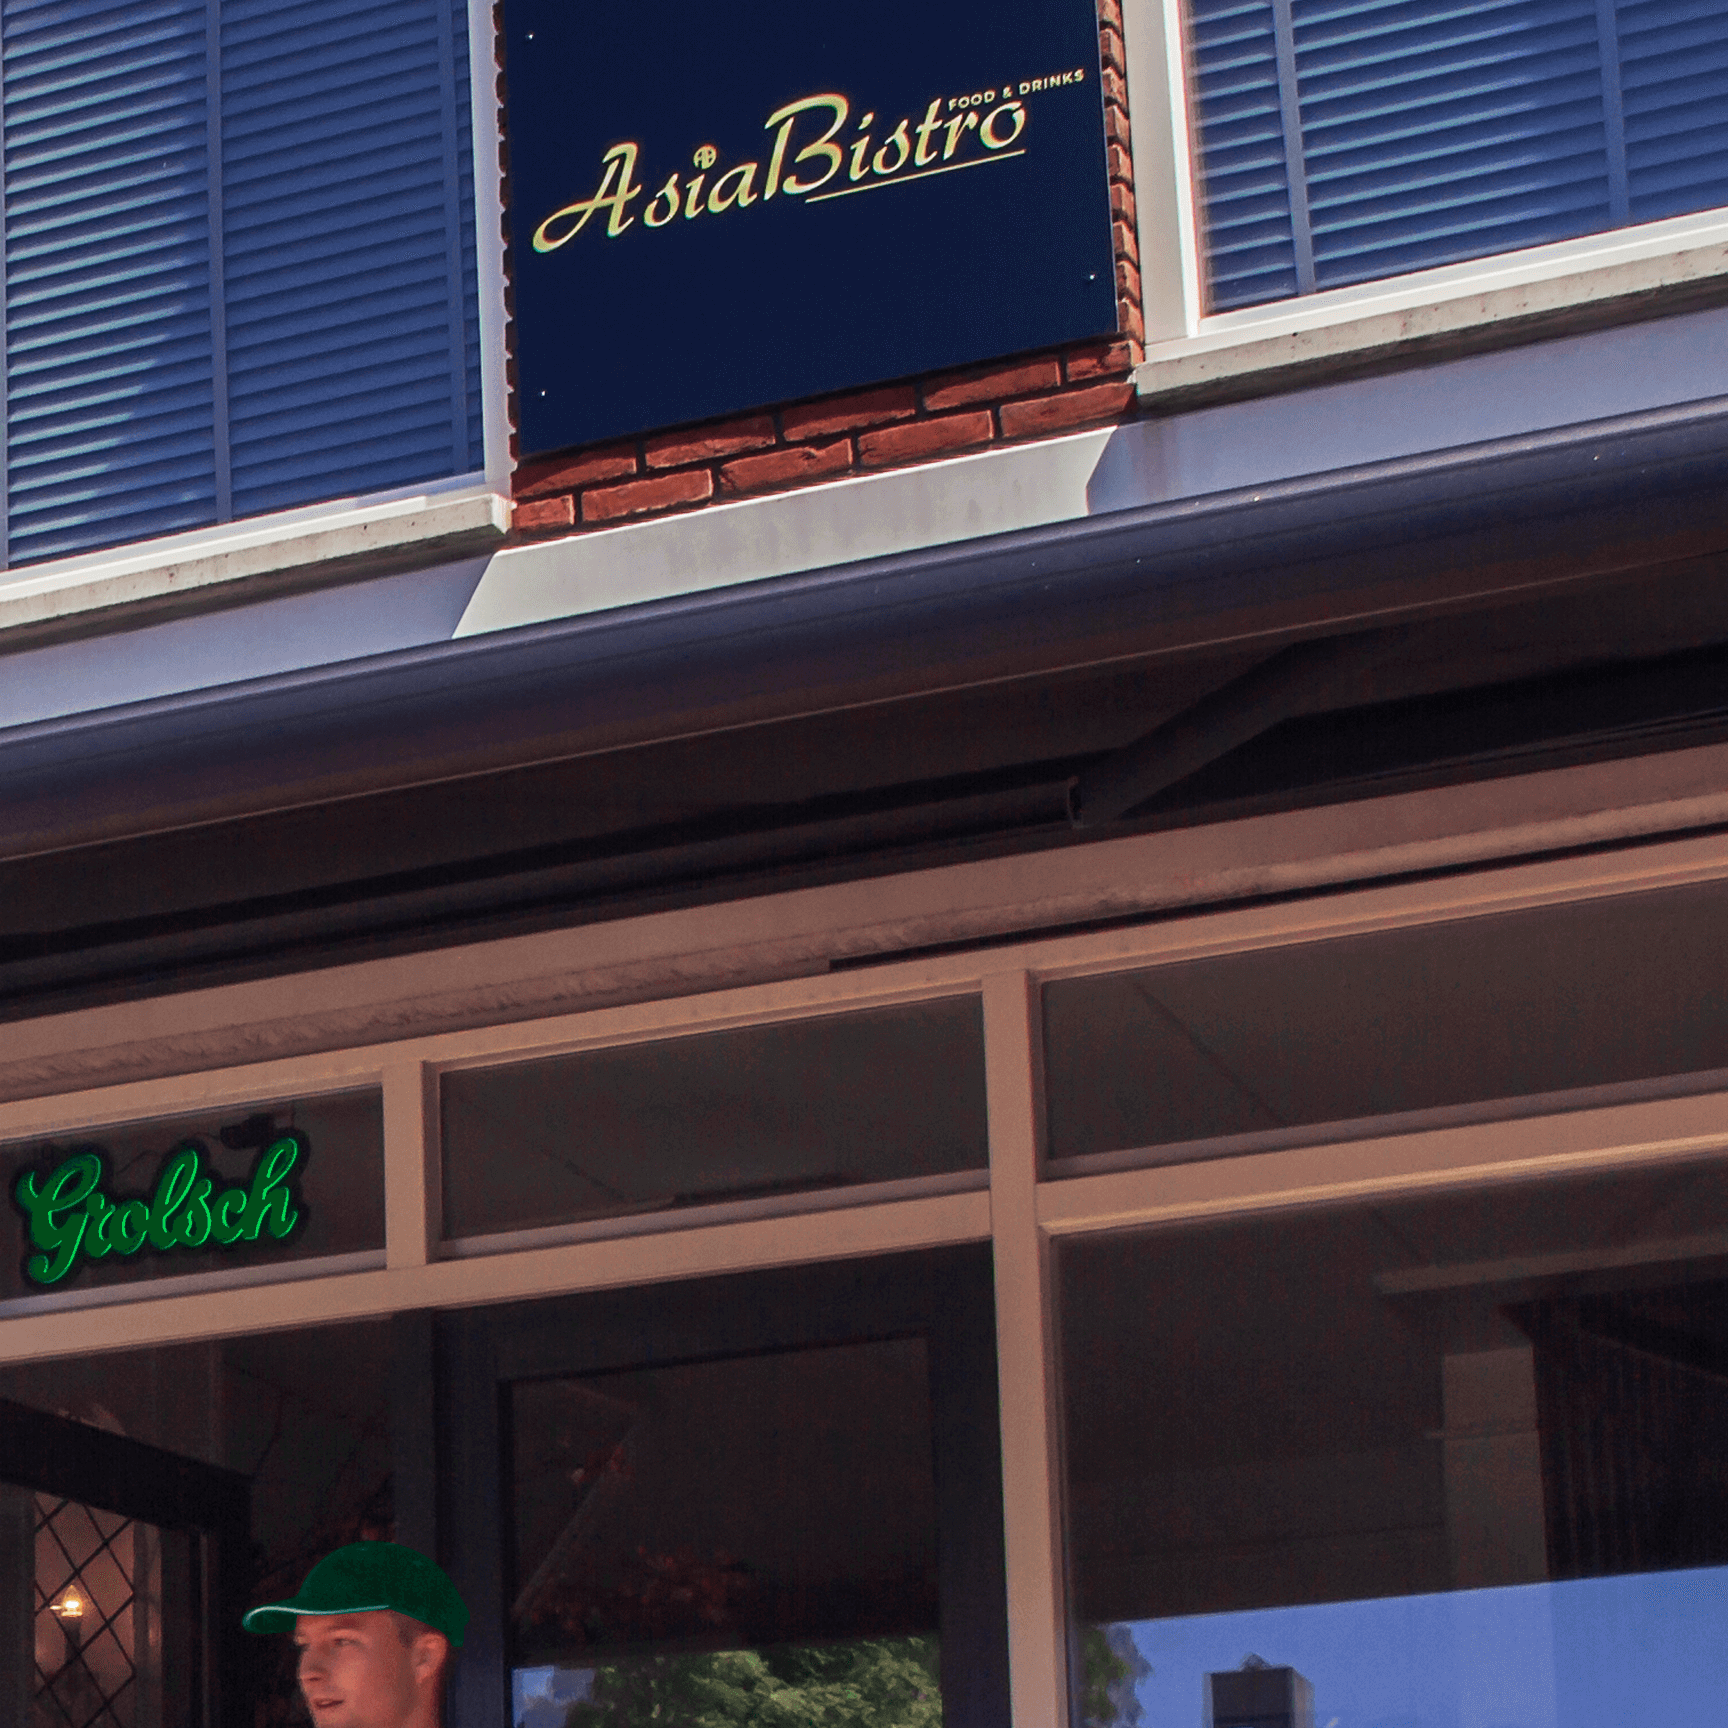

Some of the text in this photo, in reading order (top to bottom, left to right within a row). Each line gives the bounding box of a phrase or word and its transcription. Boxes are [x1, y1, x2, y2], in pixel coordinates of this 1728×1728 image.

[948, 68, 1084, 112] FOOD & DRINKS
[532, 93, 1027, 254] AsiaBistro
[15, 1137, 300, 1286] Grolsch
